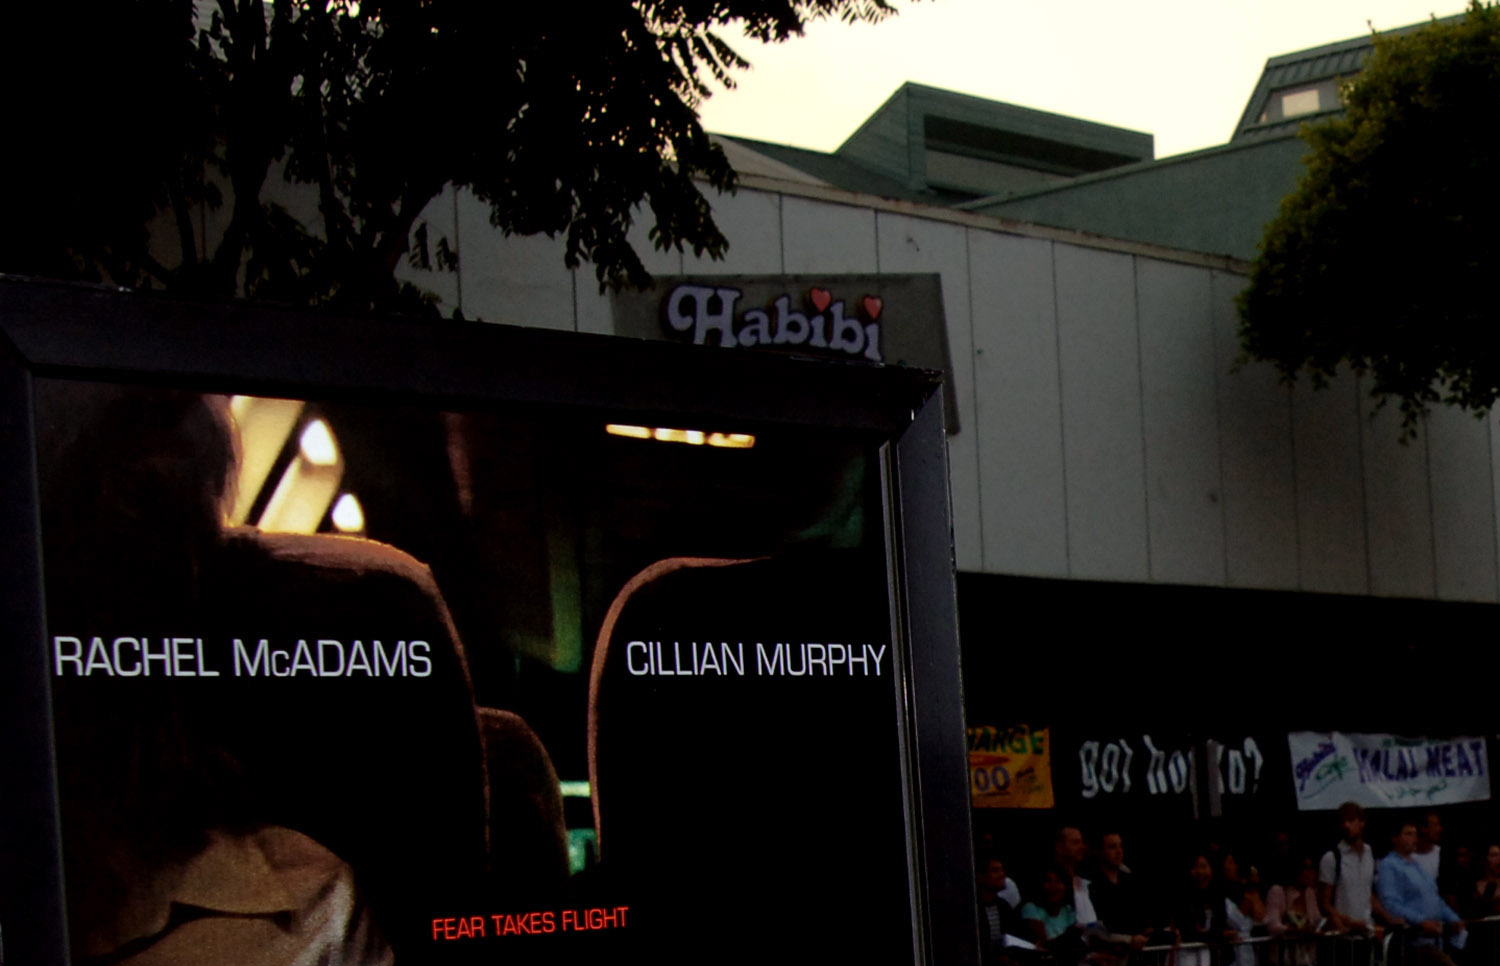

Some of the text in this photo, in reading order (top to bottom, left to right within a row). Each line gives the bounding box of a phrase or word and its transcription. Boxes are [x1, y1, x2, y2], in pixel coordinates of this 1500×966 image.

[665, 283, 884, 361] Habibi
[53, 636, 432, 678] RACHEL McADAMS
[626, 640, 887, 676] CILLIAN MURPHY
[1079, 738, 1134, 799] got
[1426, 742, 1483, 777] MEAT
[432, 906, 629, 941] FEAR TAKES FLIGHT
